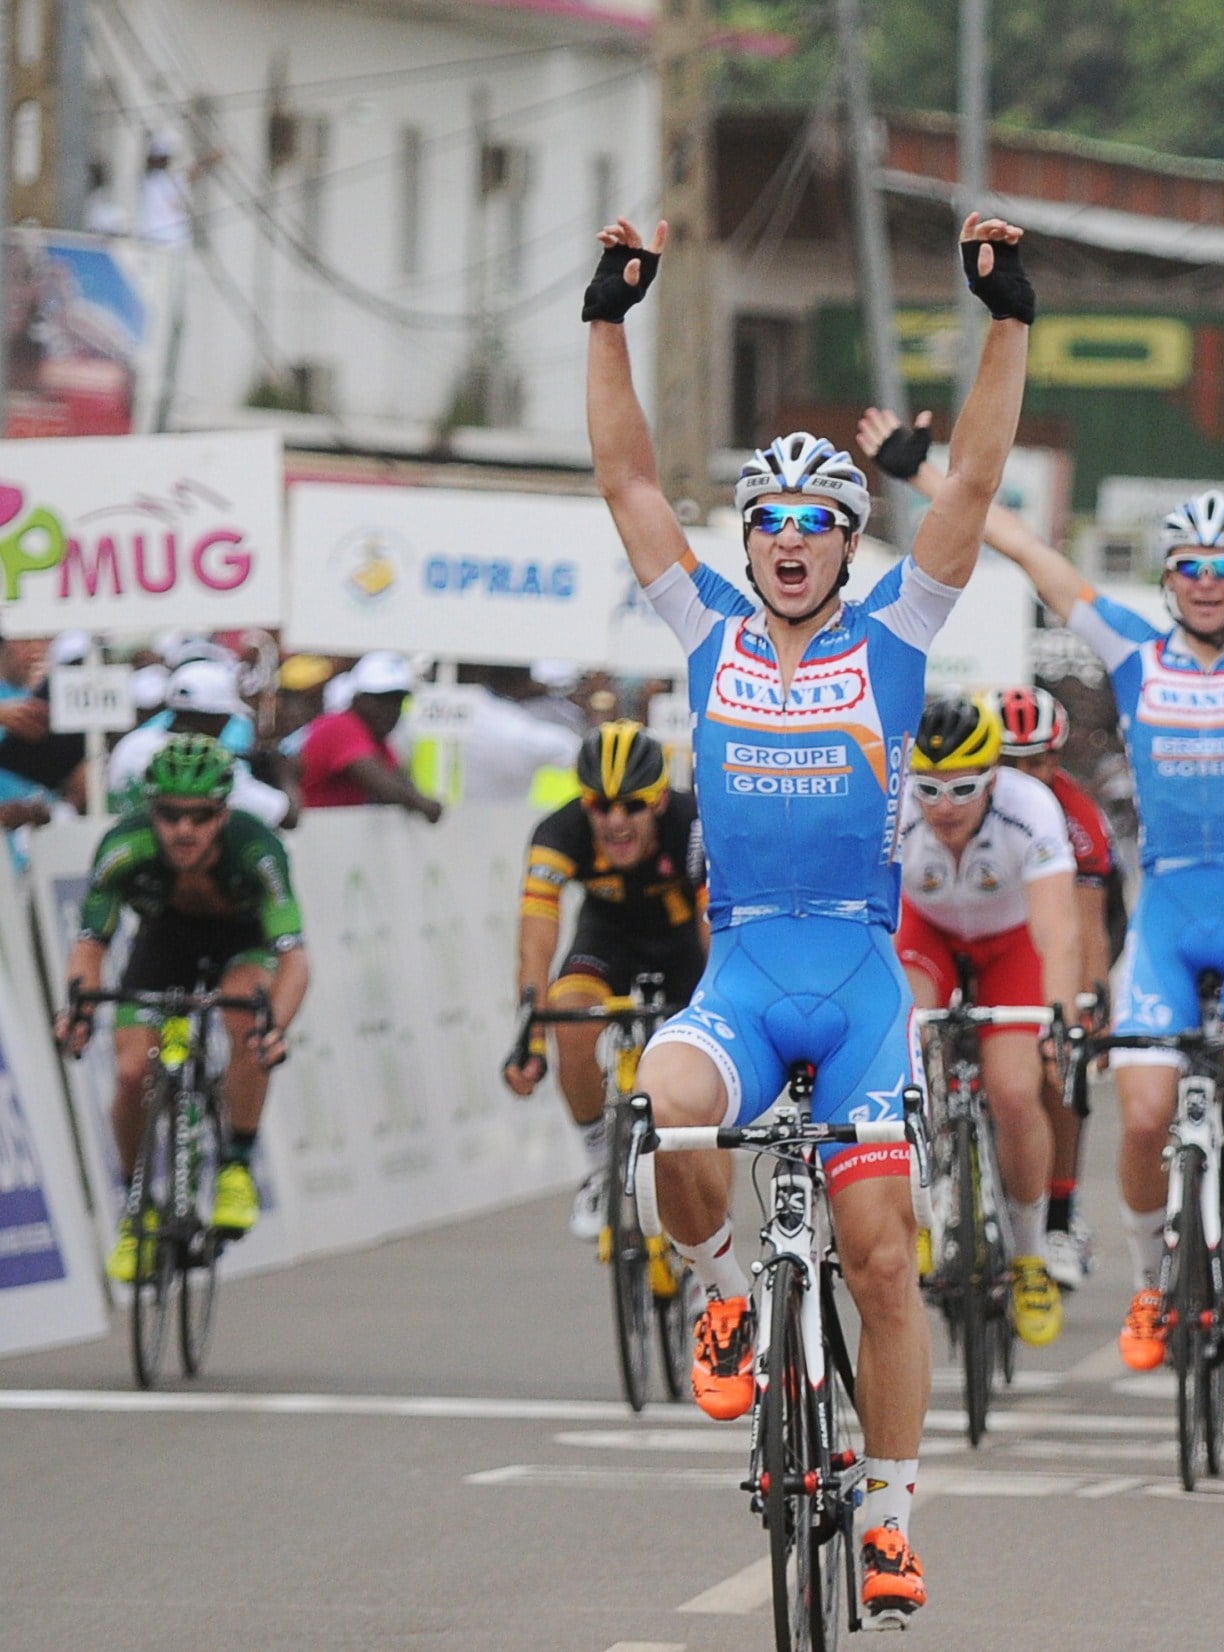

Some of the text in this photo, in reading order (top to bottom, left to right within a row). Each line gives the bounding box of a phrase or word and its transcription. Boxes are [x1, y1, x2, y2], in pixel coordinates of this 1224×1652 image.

[746, 476, 770, 487] BBB
[811, 478, 843, 489] BBB
[426, 558, 576, 597] OPRAG
[734, 678, 850, 705] WANTY
[734, 747, 838, 765] GROUPE
[733, 776, 840, 794] GOBERT
[880, 745, 901, 857] GOBERT
[861, 1150, 888, 1165] YOU
[889, 1148, 911, 1161] CLU
